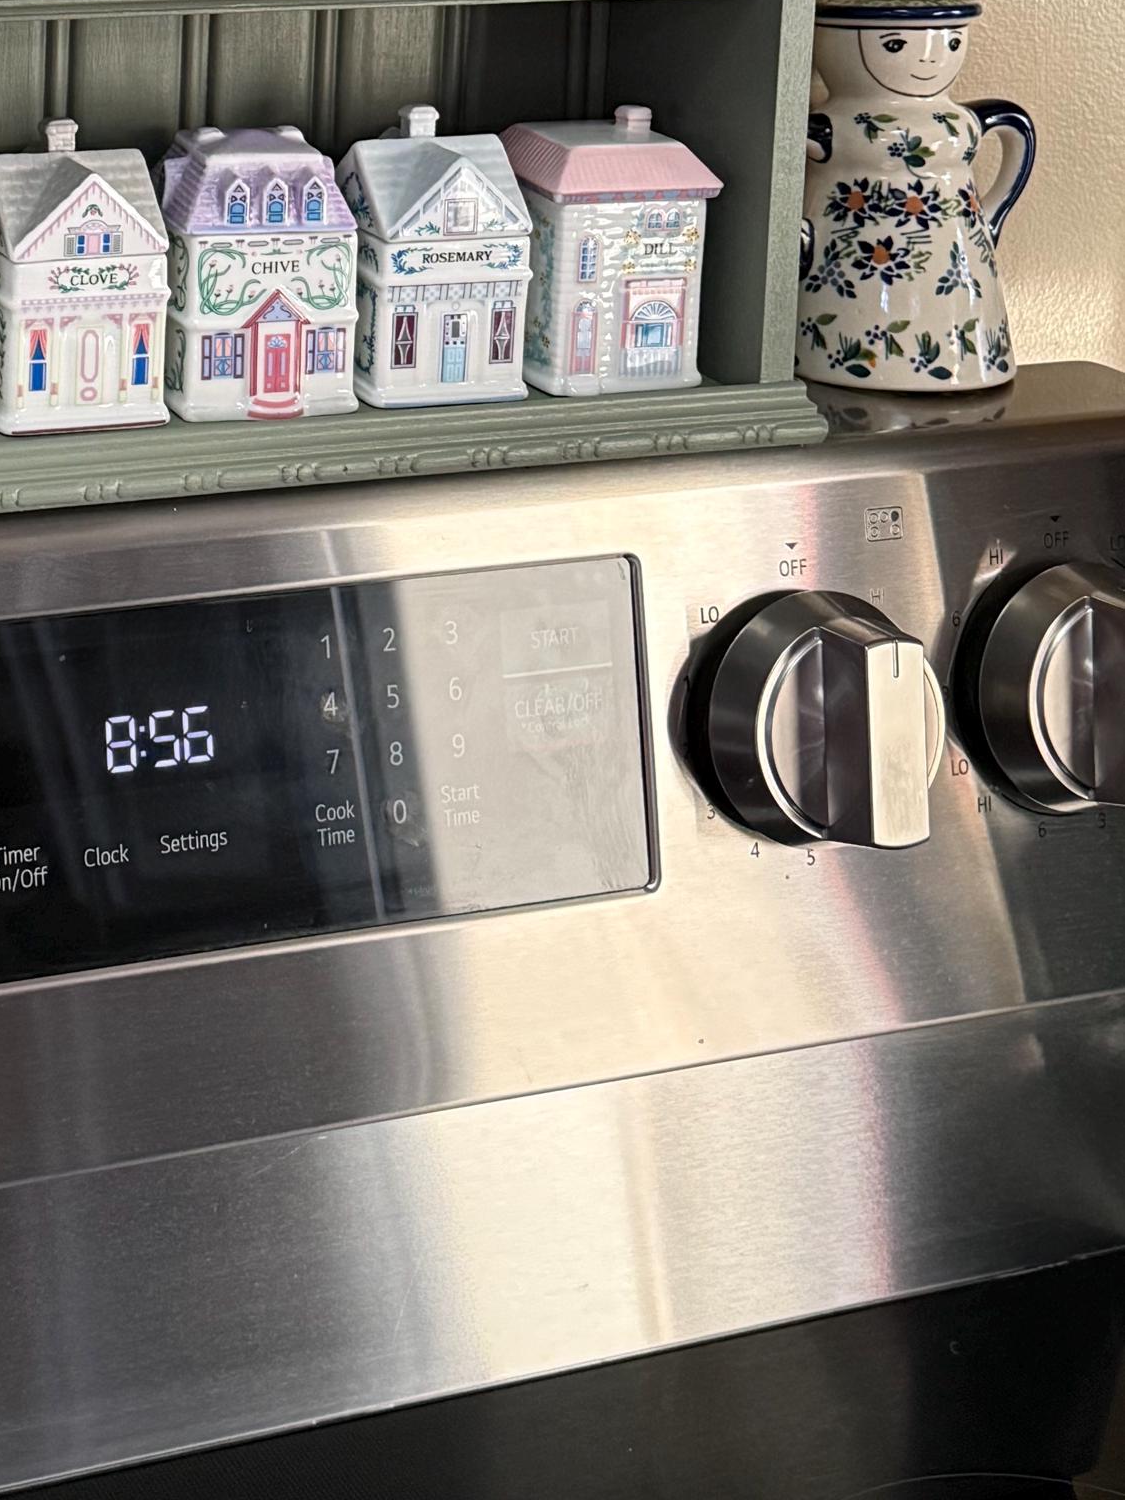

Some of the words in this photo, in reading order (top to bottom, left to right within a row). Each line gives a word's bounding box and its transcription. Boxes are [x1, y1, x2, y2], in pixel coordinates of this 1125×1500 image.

[422, 250, 493, 265] ROSEMARY
[643, 242, 678, 257] DILL
[252, 260, 300, 276] CHIVE
[69, 273, 119, 287] CLOVE
[1044, 532, 1069, 548] OFF
[989, 549, 1003, 565] HI
[779, 559, 807, 577] OFF
[870, 589, 884, 605] HI
[700, 606, 719, 625] LO
[321, 635, 331, 659] 1
[383, 628, 396, 652] 2
[445, 620, 458, 644] 3
[531, 627, 579, 649] START
[324, 692, 338, 716] 4
[387, 684, 400, 708] 5
[449, 677, 462, 700] 6
[105, 705, 214, 774] 8:56
[326, 750, 340, 774] 7
[389, 742, 404, 765] 8
[452, 734, 465, 757] 9
[952, 759, 969, 776] LO
[441, 784, 479, 803] Start
[315, 800, 355, 822] Cook
[393, 800, 407, 824] 0
[707, 803, 716, 819] 3
[977, 797, 992, 813] HI
[444, 810, 480, 827] Time
[317, 826, 355, 847] Time
[1038, 821, 1047, 838] 6
[160, 831, 228, 855] Settings
[750, 842, 760, 858] 4
[84, 844, 129, 868] Clock
[807, 849, 816, 866] 5
